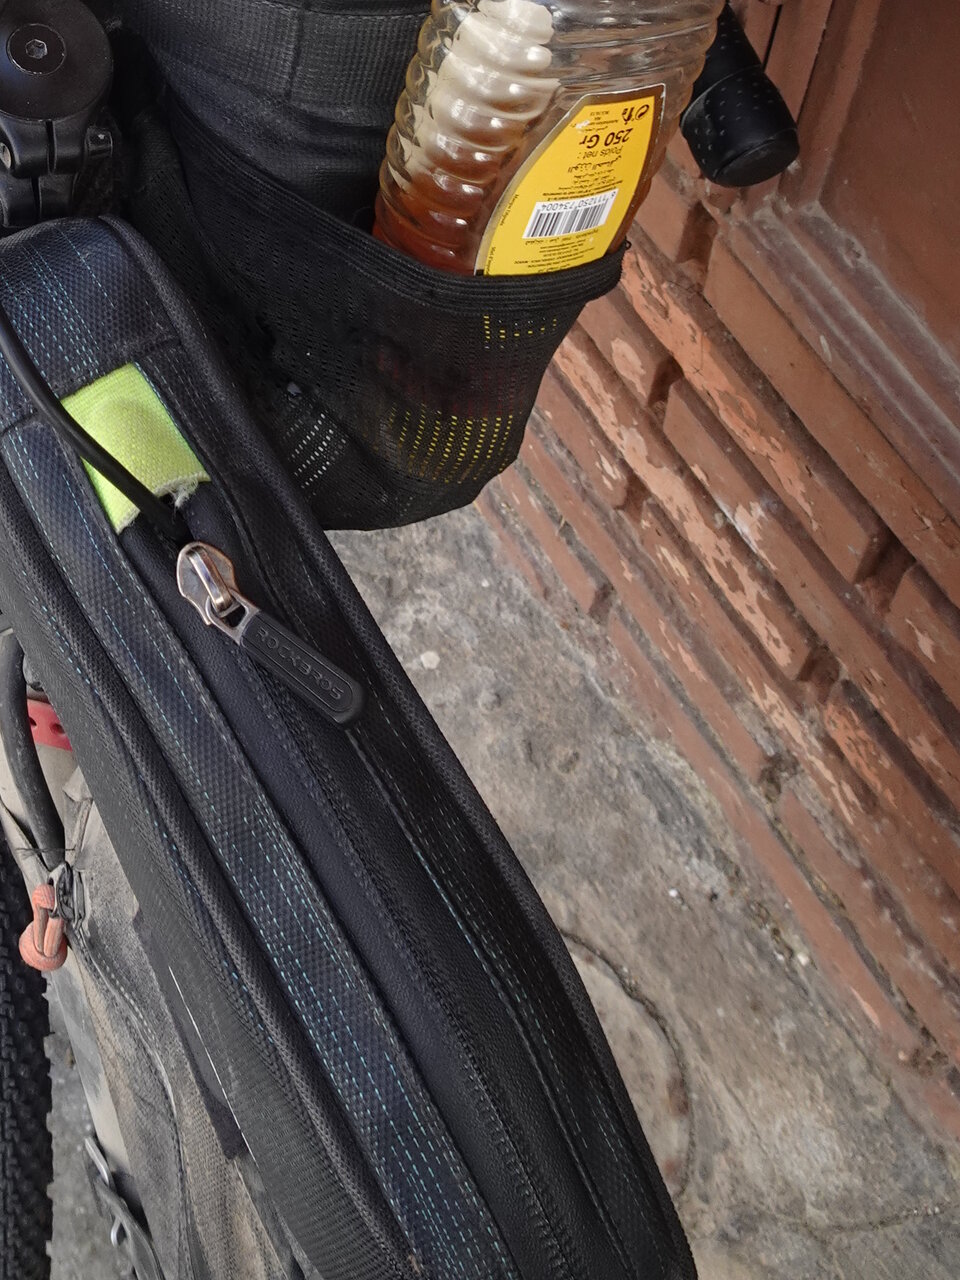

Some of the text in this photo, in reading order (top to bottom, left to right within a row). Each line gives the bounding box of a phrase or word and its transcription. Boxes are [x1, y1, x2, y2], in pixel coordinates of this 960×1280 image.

[579, 128, 634, 149] 250 Gr
[599, 145, 624, 160] Poids
[256, 626, 344, 700] ROCKBROS
